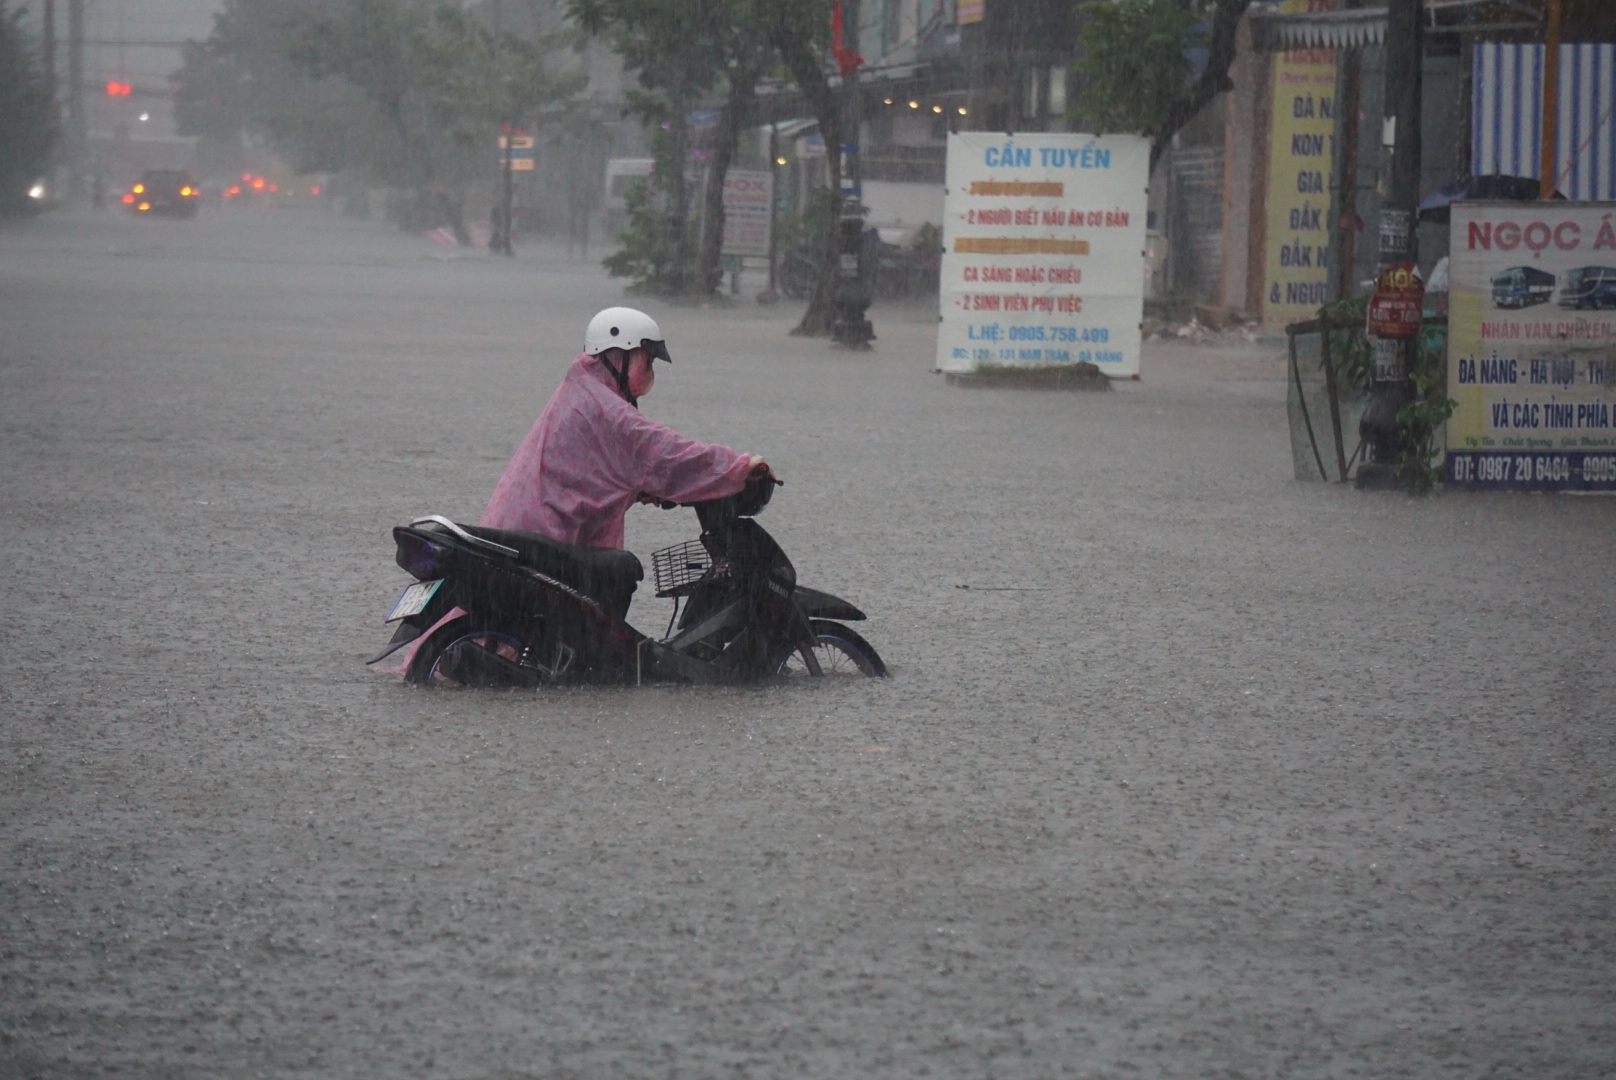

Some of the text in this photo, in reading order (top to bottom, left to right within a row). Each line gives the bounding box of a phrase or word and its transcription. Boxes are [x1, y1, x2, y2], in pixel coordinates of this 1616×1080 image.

[985, 140, 1111, 169] CẦN TUYỂN
[1291, 133, 1324, 157] KON
[1297, 169, 1323, 194] GIA
[967, 208, 976, 225] 2
[1015, 204, 1040, 227] BIẾT
[1042, 205, 1066, 228] NẤU
[1467, 221, 1581, 259] NGỌC
[964, 266, 978, 282] CA
[981, 264, 1013, 283] SÁNG
[963, 294, 971, 311] 2
[973, 294, 1000, 312] SINH
[1003, 293, 1029, 312] VIÊN
[1031, 296, 1054, 316] PHỤ
[1057, 294, 1083, 316] VIỆC
[968, 322, 1109, 344] L.HỆ: 0905.758.499
[1458, 354, 1476, 385] ĐÀ
[1492, 398, 1509, 428] VÀ
[1513, 398, 1539, 428] CÁC
[1543, 395, 1574, 429] TỈNH
[1578, 398, 1609, 429] PHÍA
[1454, 456, 1474, 481] ĐT:
[1478, 456, 1511, 481] 0987
[1514, 456, 1532, 481] 20
[1536, 456, 1569, 481] 6464
